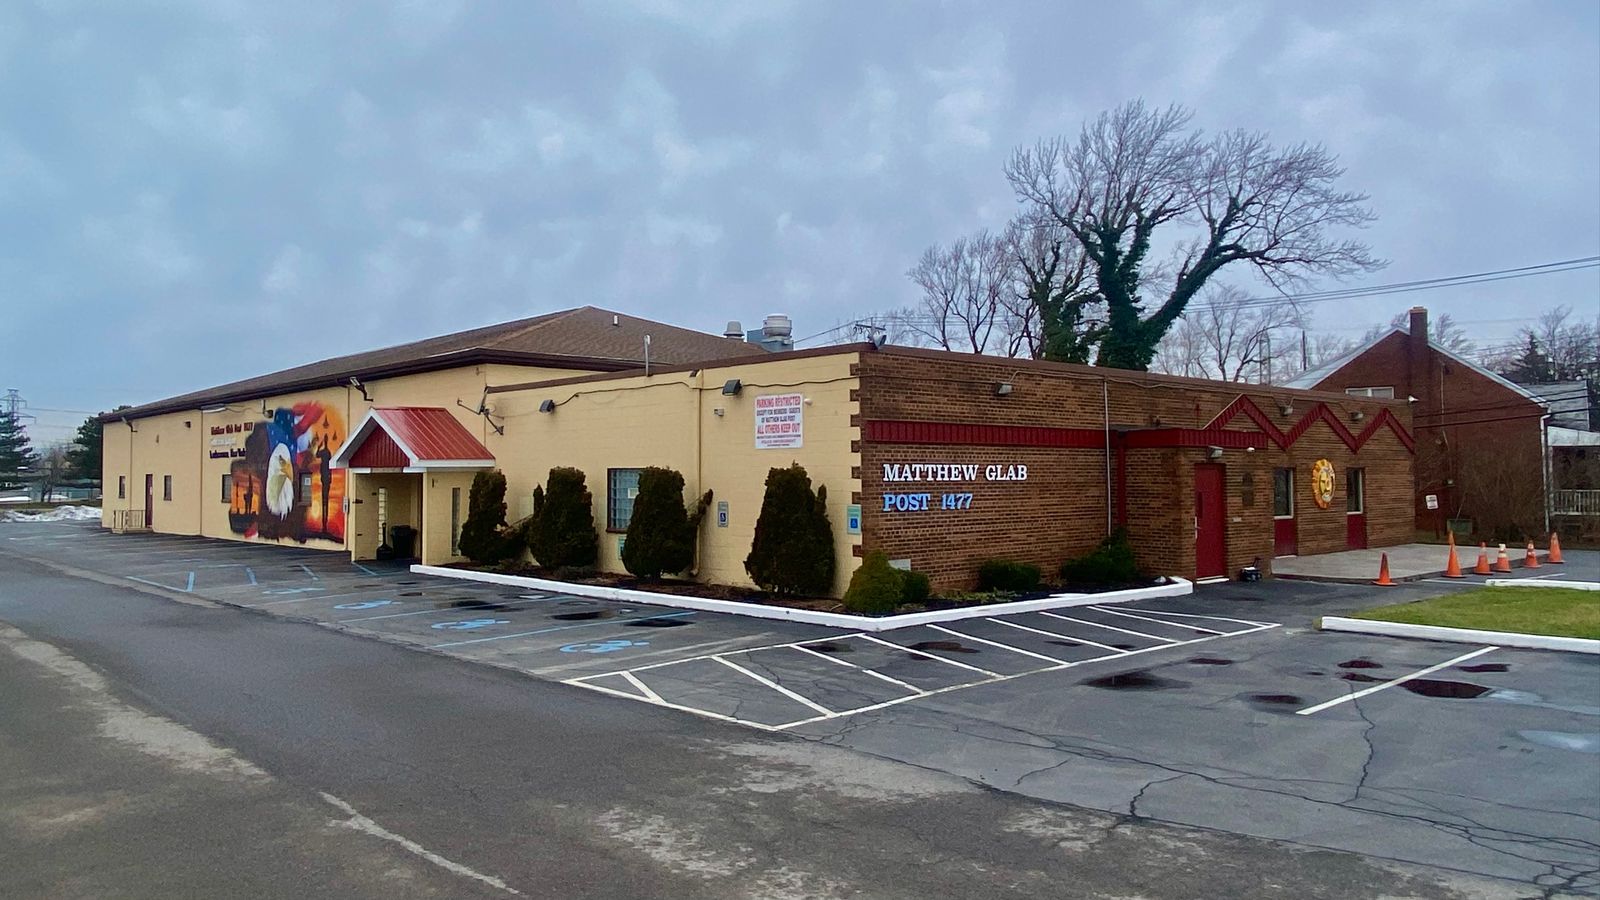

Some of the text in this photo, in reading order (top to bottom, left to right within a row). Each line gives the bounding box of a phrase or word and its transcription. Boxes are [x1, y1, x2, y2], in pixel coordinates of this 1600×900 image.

[756, 396, 801, 408] PARKING RESTRICTED
[765, 423, 780, 434] OTHERS
[781, 423, 791, 433] KEEP
[792, 422, 800, 433] OUT
[883, 463, 1028, 481] MATTHEW GLAB
[883, 493, 974, 511] POST 1477
